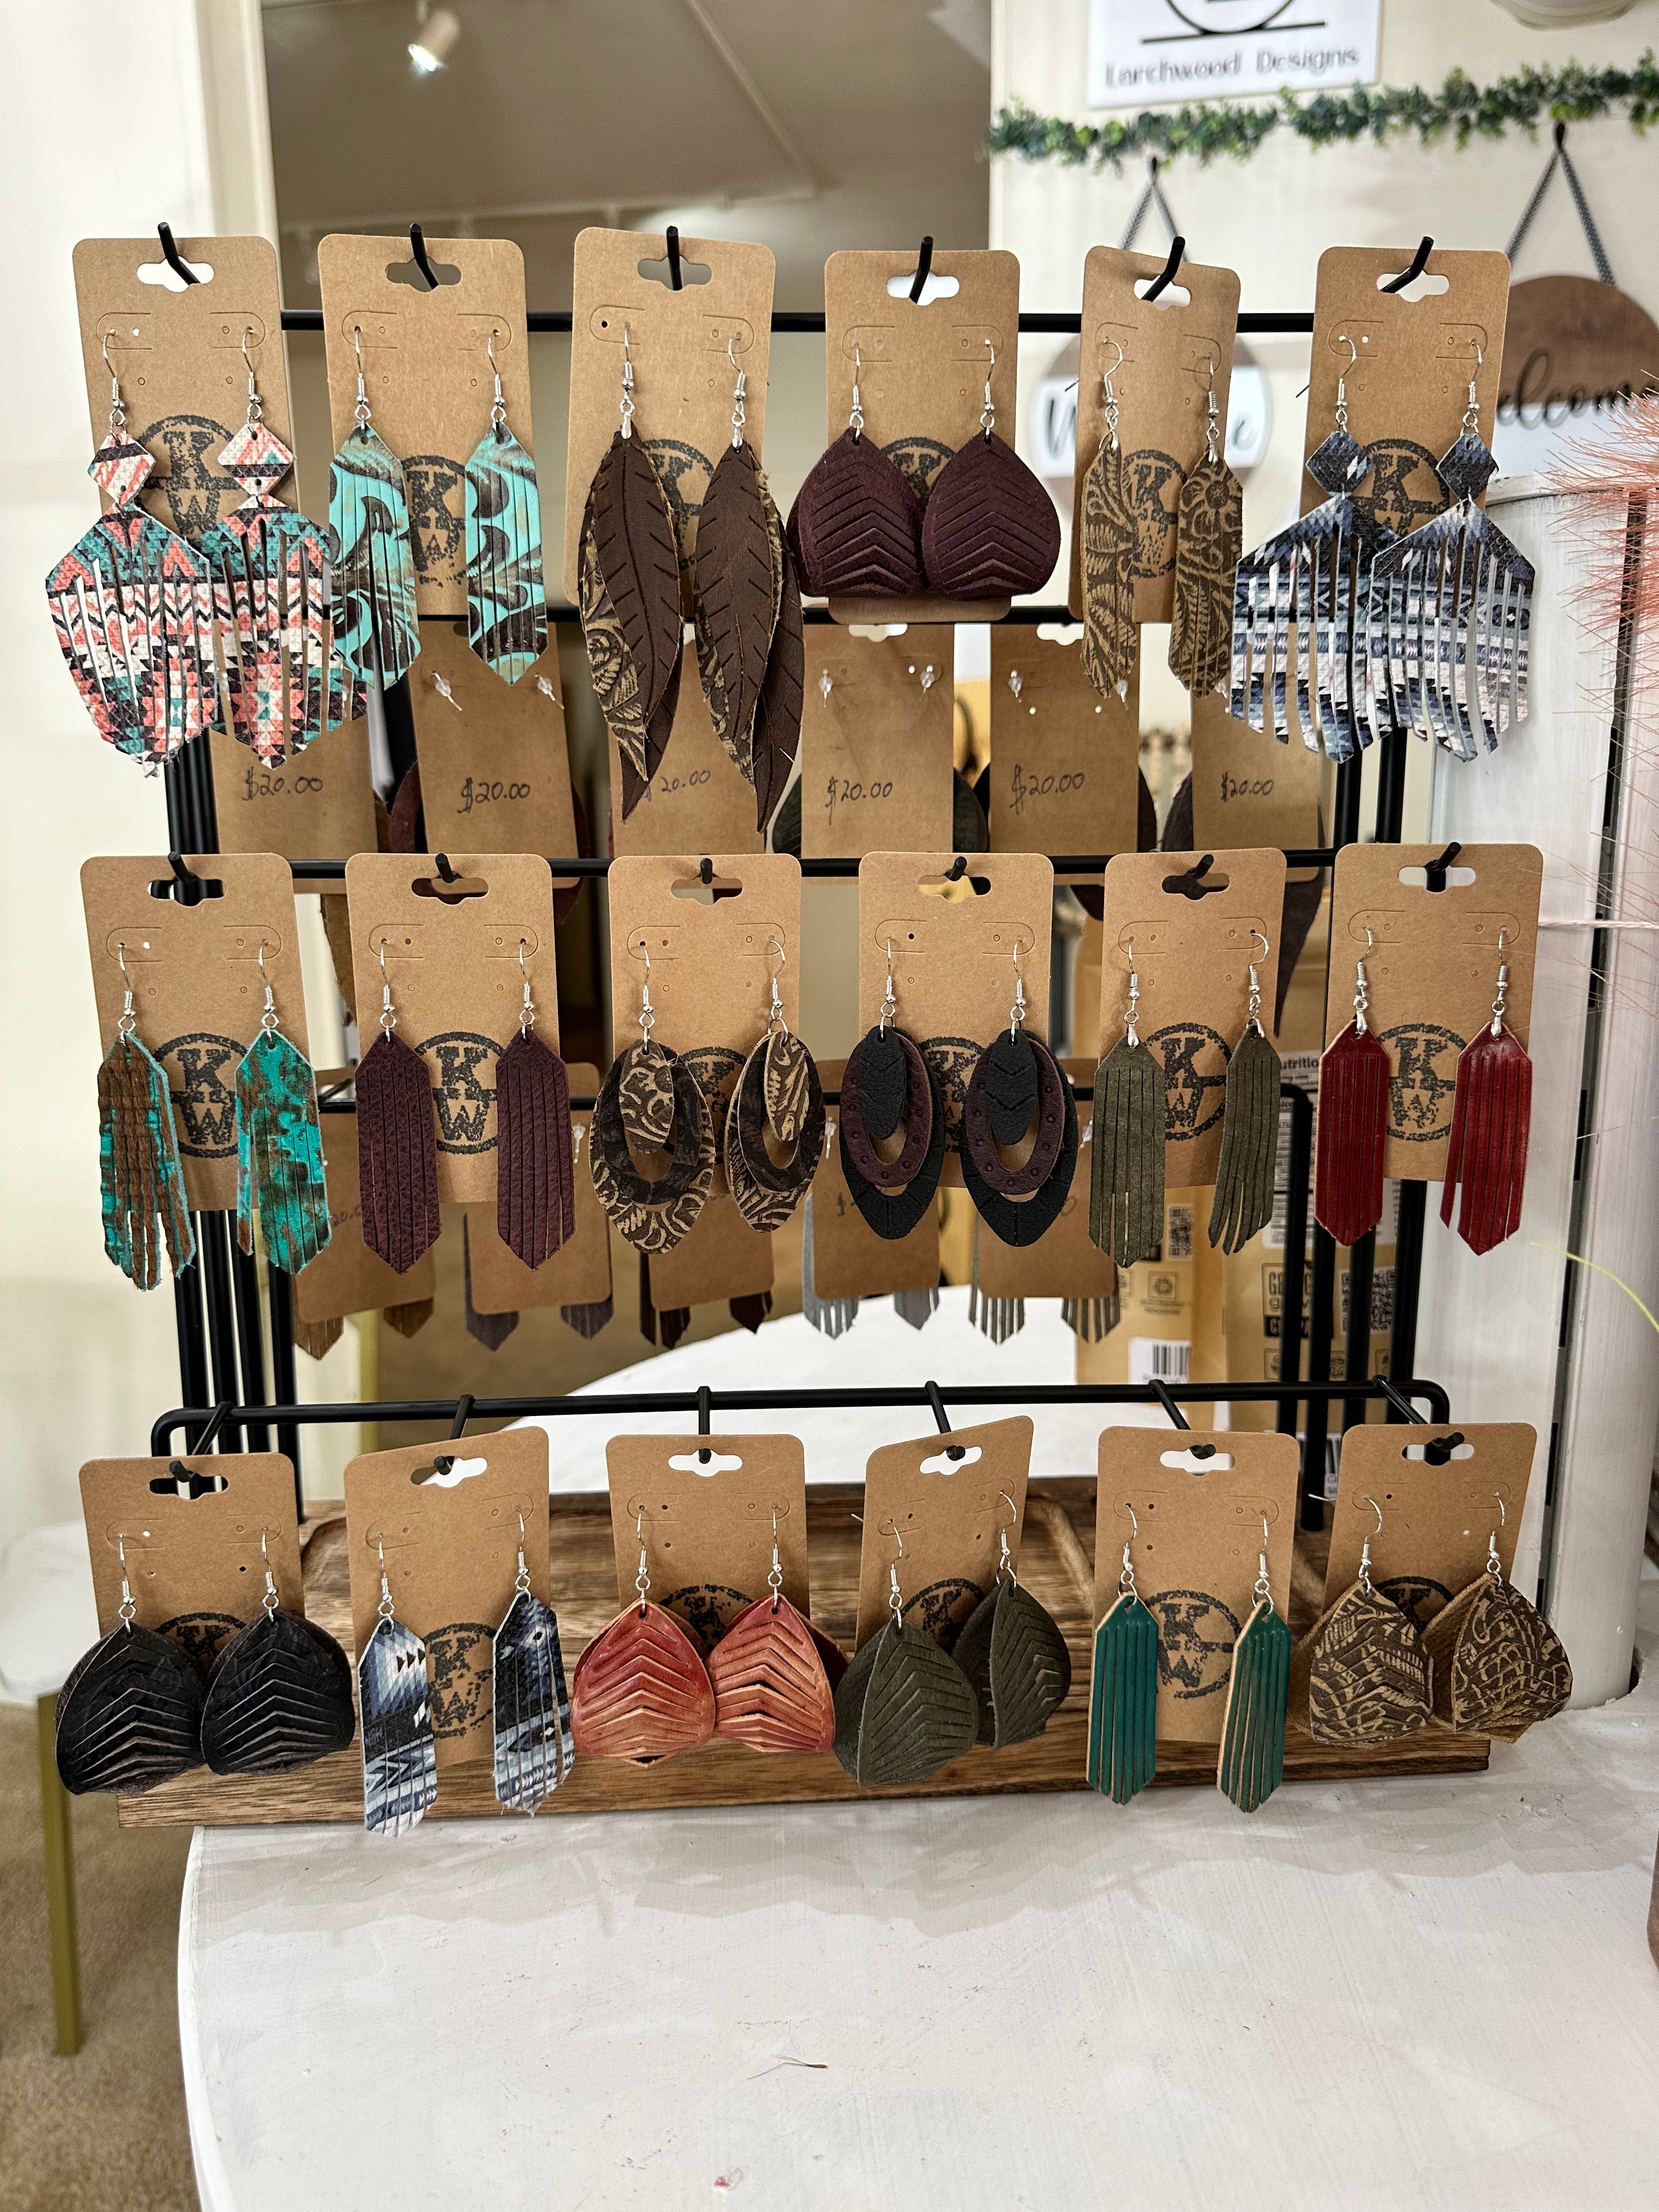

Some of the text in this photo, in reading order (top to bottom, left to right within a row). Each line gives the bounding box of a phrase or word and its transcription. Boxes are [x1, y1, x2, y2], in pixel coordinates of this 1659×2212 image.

[1105, 47, 1359, 87] Larchwood Designs
[242, 766, 324, 801] $20.00
[457, 777, 531, 814] $20.00
[825, 776, 893, 825] $20.00
[1009, 765, 1085, 815] $20.00
[1221, 772, 1273, 802] $20.00
